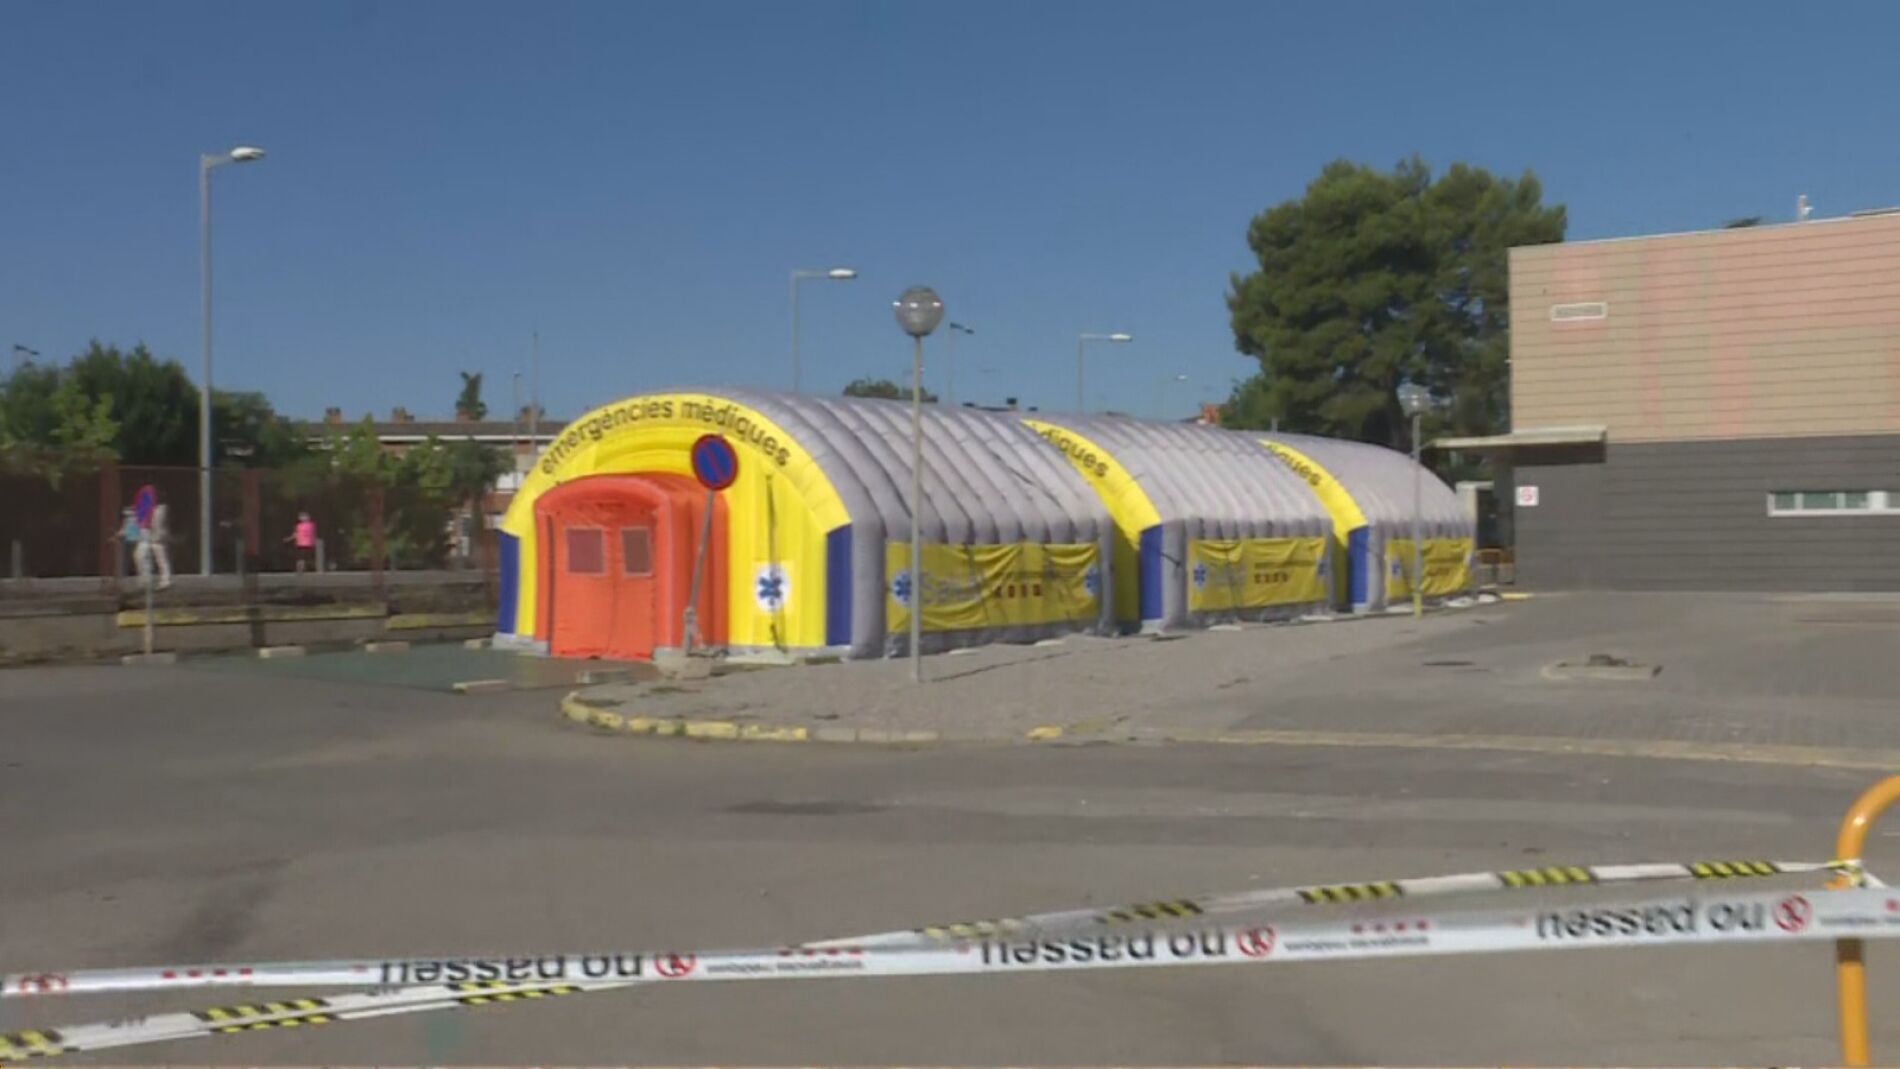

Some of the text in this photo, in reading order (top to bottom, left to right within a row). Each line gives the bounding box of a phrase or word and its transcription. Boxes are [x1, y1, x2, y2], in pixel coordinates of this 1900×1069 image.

[541, 398, 792, 475] emergències mèdiques
[1537, 901, 1766, 939] no passeu
[581, 952, 642, 977] no
[980, 930, 1226, 966] no passeu
